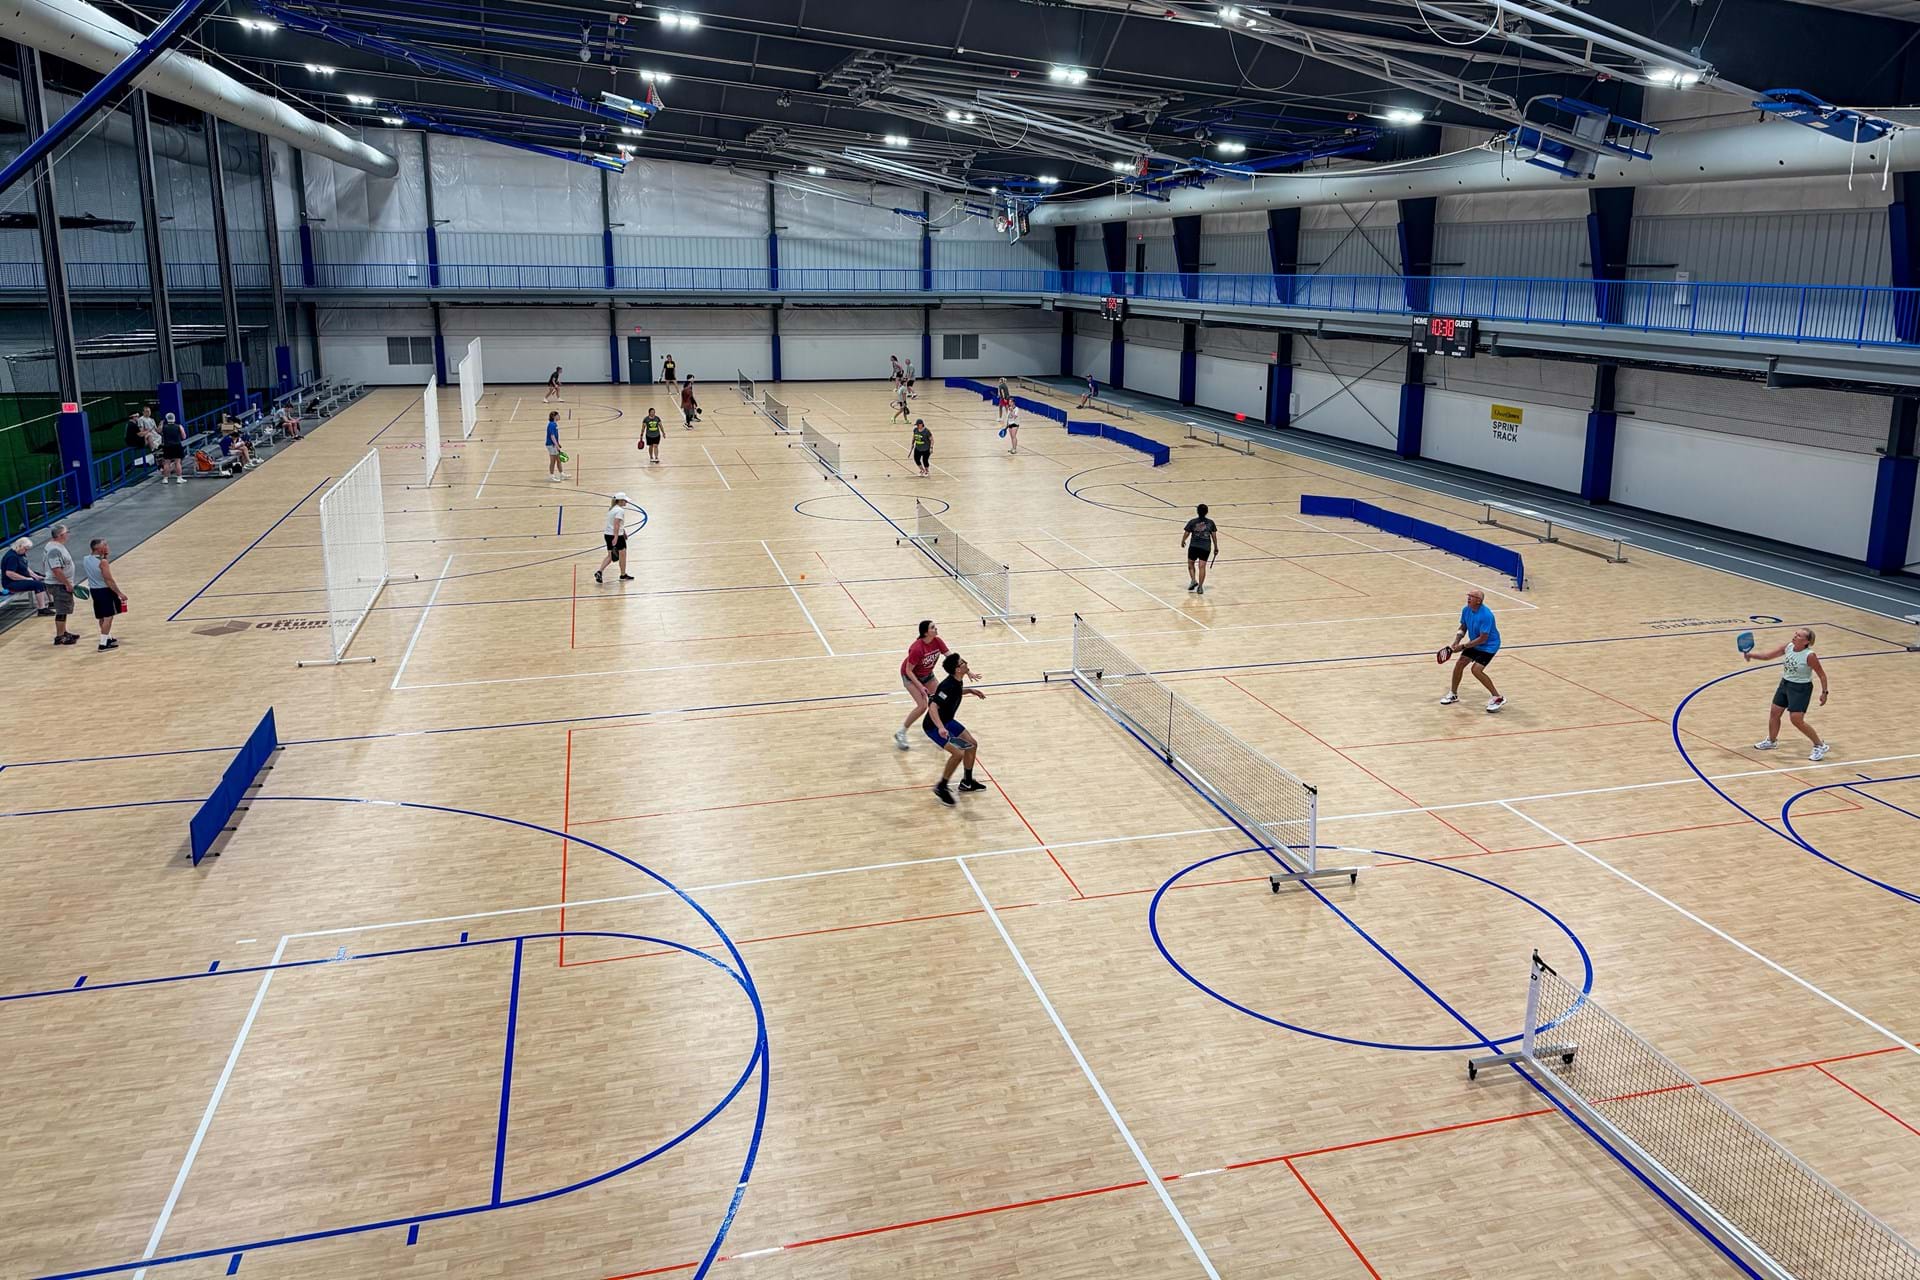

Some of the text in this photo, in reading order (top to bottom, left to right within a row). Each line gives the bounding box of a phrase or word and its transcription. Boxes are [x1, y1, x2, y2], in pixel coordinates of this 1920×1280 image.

[1413, 317, 1429, 325] HOME
[1454, 319, 1473, 328] GUEST
[1431, 319, 1455, 337] 10:38
[1492, 421, 1519, 432] SPRINT
[1492, 430, 1517, 442] TRACK
